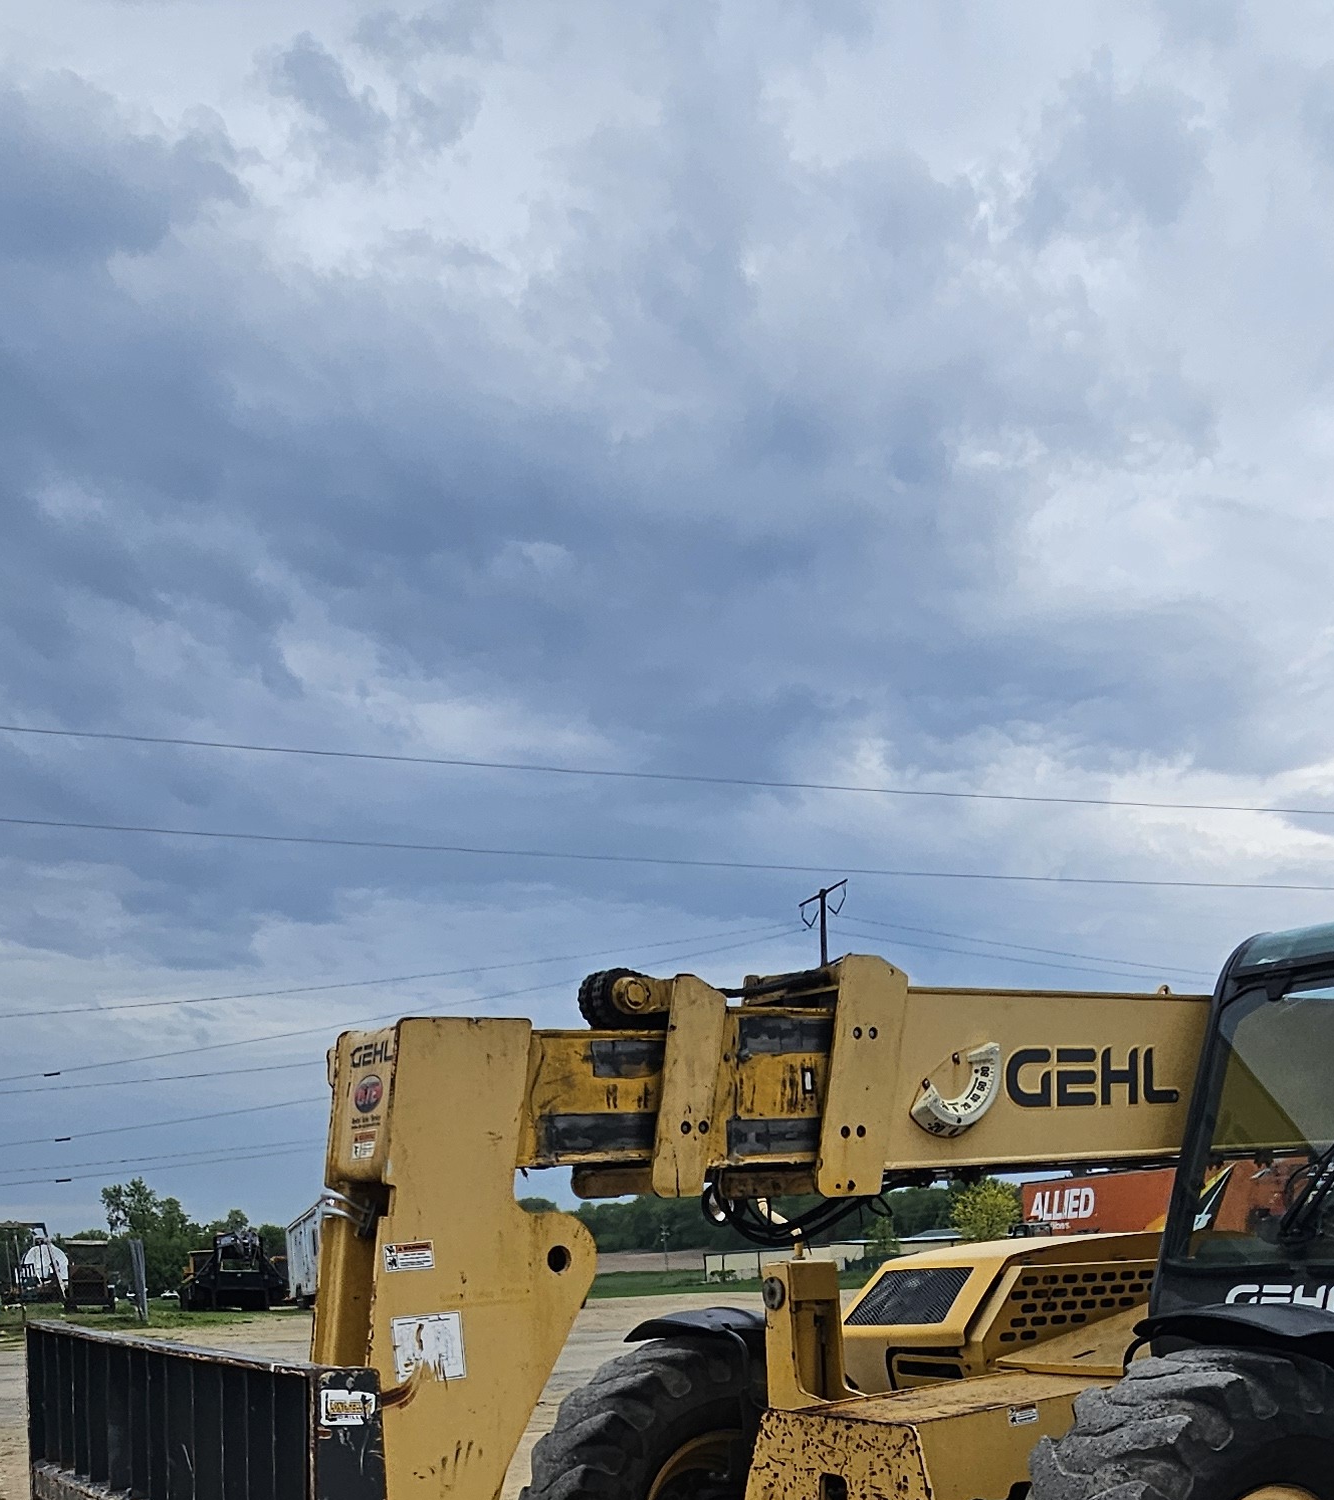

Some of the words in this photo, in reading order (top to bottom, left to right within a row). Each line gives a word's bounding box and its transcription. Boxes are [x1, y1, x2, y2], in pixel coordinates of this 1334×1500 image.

[350, 1040, 394, 1068] GEHL
[1005, 1047, 1179, 1107] GEHL
[1030, 1187, 1095, 1221] ALLIED
